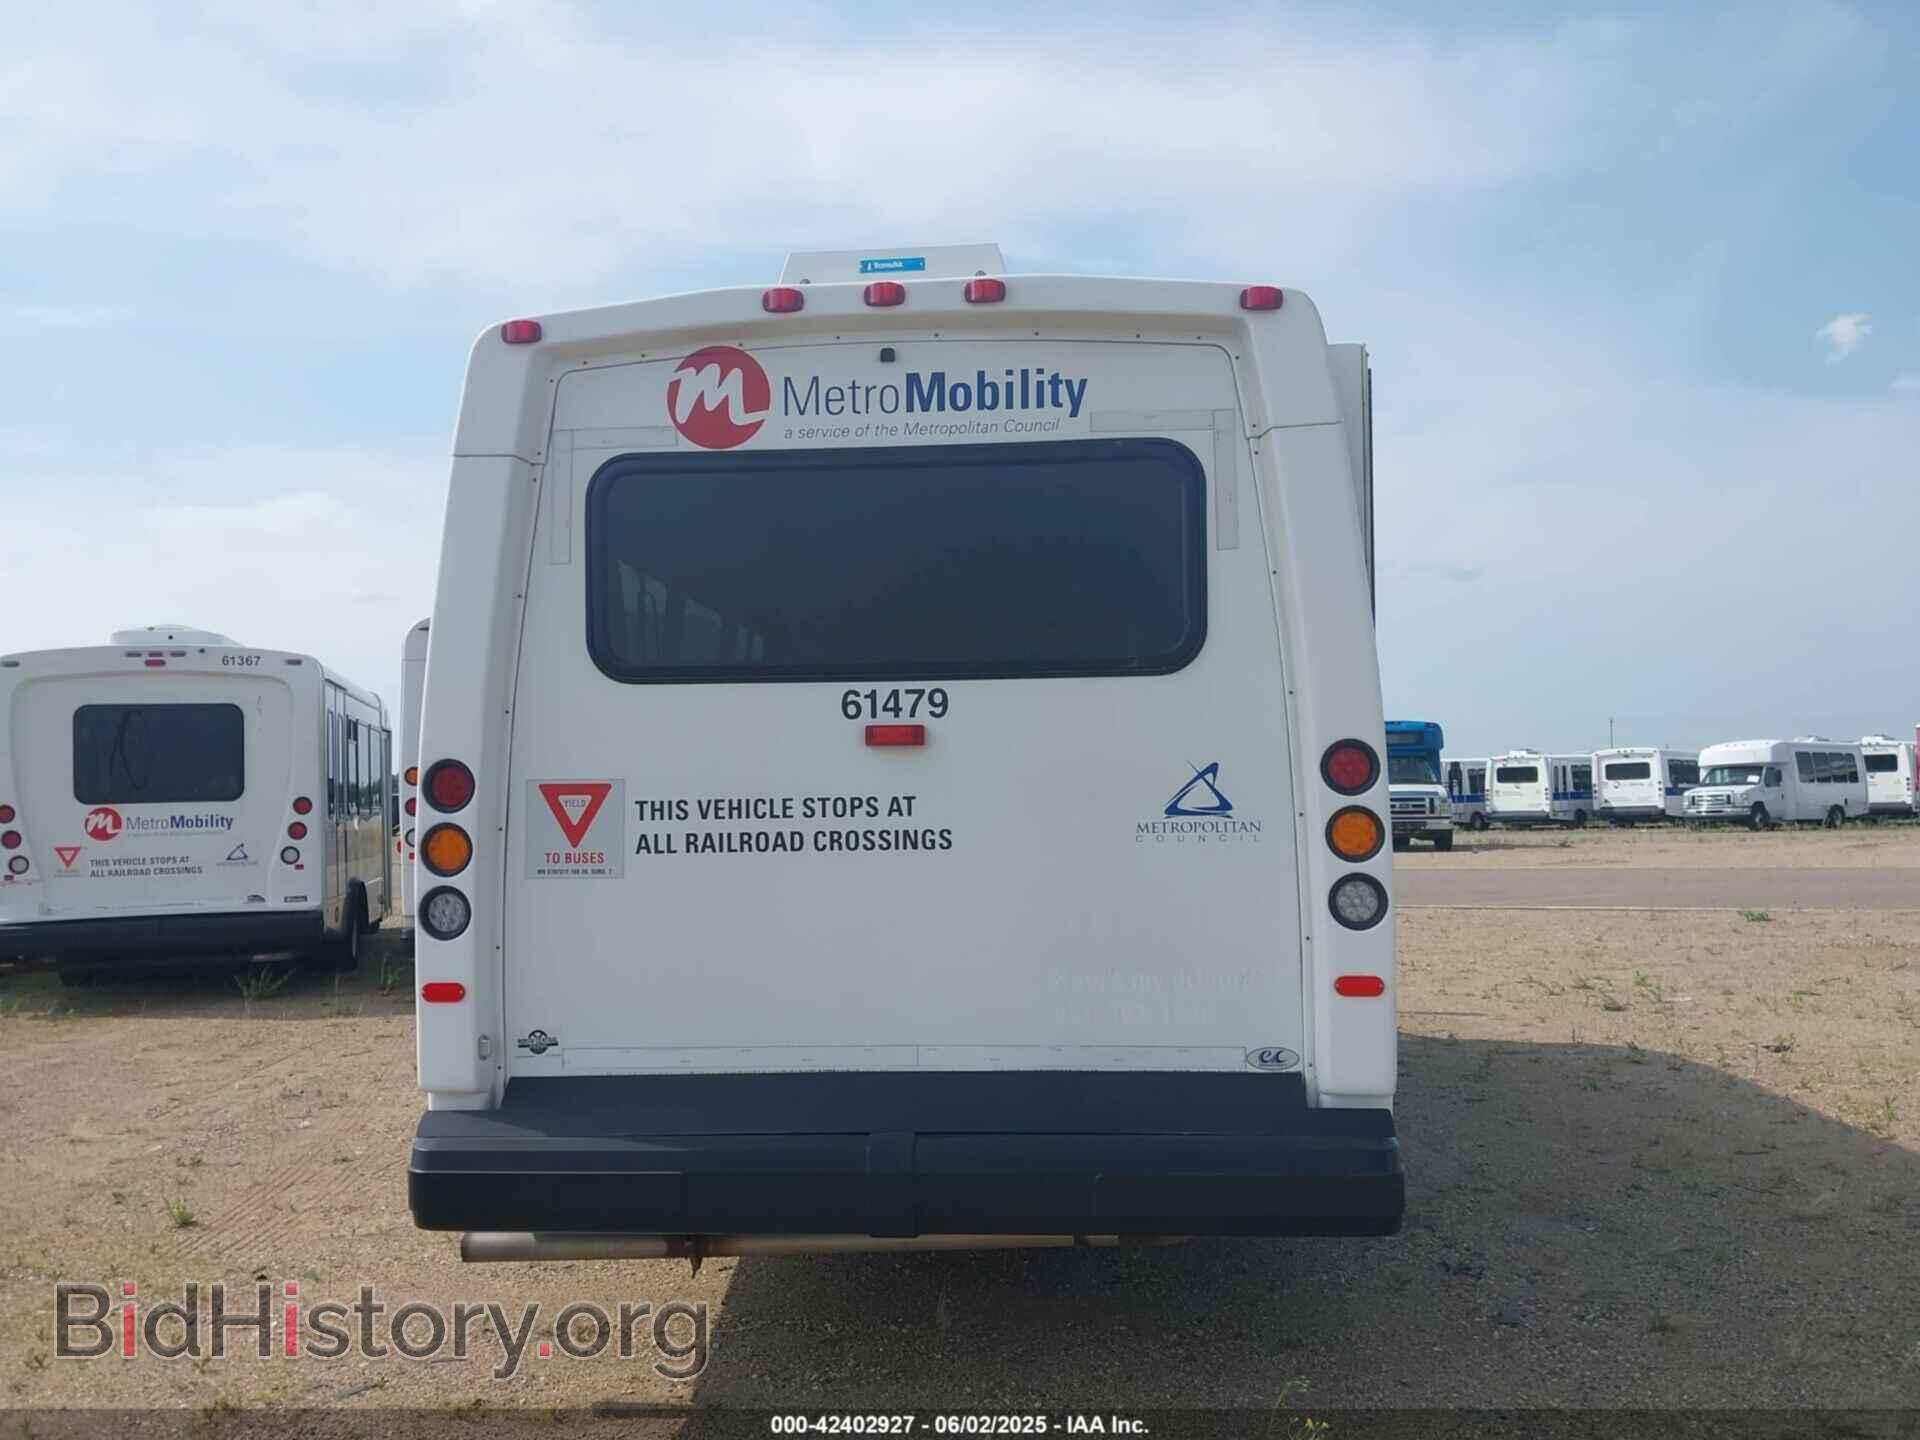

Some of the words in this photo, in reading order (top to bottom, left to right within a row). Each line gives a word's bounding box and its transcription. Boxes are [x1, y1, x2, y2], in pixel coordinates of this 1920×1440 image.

[783, 367, 1089, 418] MetroMobility
[784, 428, 793, 439] a
[798, 425, 850, 439] service
[854, 424, 870, 438] of
[874, 423, 898, 437] the
[903, 421, 999, 437] Metropolitan
[1003, 418, 1060, 433] Council
[222, 655, 261, 666] 61367
[841, 688, 949, 720] 61479
[564, 799, 586, 808] YIELD
[635, 800, 690, 821] THIS
[698, 797, 795, 820] VEHICLE
[802, 796, 879, 819] STOPS
[887, 796, 917, 817] AT
[126, 814, 234, 831] MetroMobility
[1136, 821, 1262, 834] METROPOLITAN
[635, 833, 677, 855] ALL
[685, 831, 804, 854] RAILROAD
[813, 828, 953, 852] CROSSINGS
[1136, 834, 1262, 843] COUNCIL
[90, 858, 110, 867] THIS
[112, 858, 146, 867] VEHICLE
[150, 856, 177, 866] STOPS
[544, 852, 560, 864] TO
[564, 852, 605, 864] BUSES
[90, 869, 105, 878] ALL
[108, 868, 151, 877] RAILROAD
[153, 866, 203, 876] CROSSINGS
